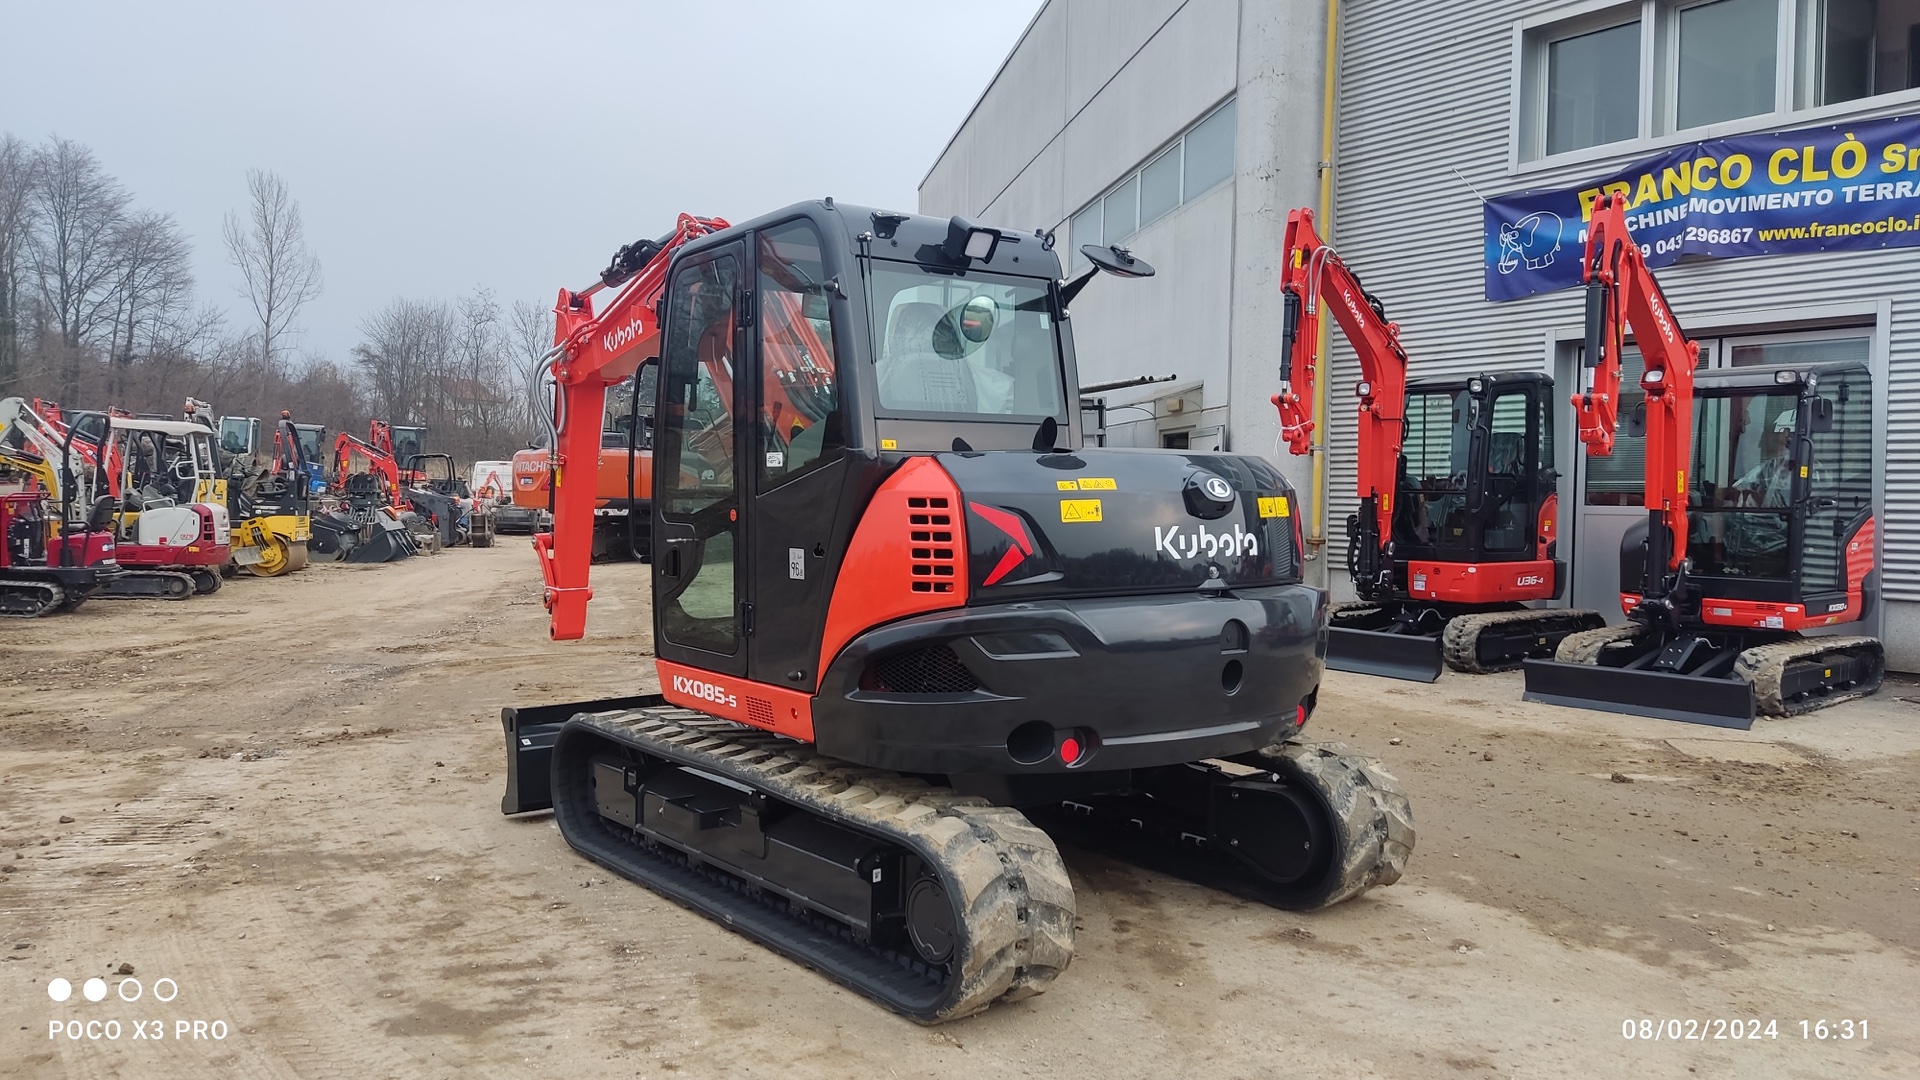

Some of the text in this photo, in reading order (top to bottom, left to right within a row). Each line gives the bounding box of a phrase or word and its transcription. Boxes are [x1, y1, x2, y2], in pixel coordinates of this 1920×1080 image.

[1578, 153, 1753, 223] FRANCO
[1767, 132, 1868, 186] CLÒ
[1578, 201, 1689, 244] MCHINE
[1688, 188, 1834, 215] MOVIMENTO
[1684, 226, 1754, 245] 296867
[1343, 288, 1365, 329] Kubota
[1650, 292, 1674, 344] Kubota
[603, 317, 643, 352] Kubota
[1154, 523, 1259, 560] Kubota
[673, 674, 737, 708] KX085-5
